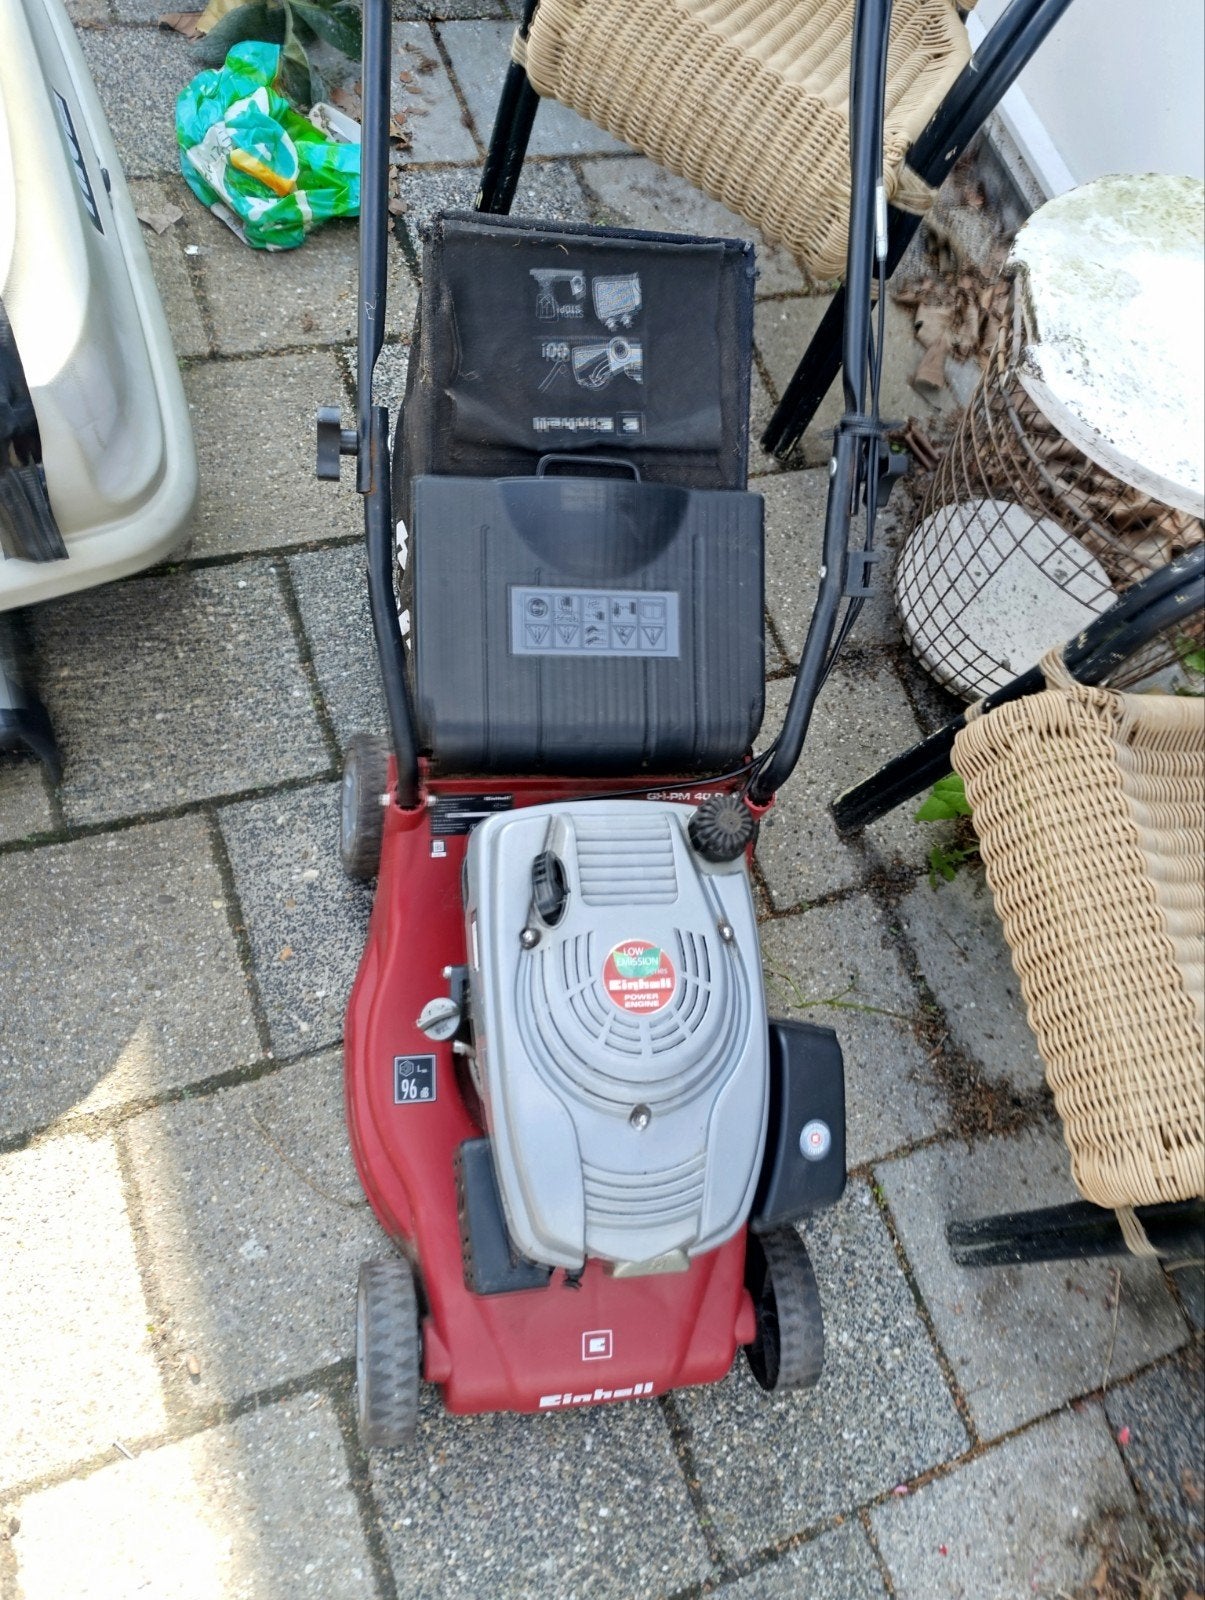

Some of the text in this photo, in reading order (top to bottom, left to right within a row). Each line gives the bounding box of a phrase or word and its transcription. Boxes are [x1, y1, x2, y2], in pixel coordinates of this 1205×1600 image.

[533, 417, 615, 434] Einhell
[646, 792, 691, 801] GH-PM
[694, 792, 711, 801] 40
[623, 947, 644, 956] LOW
[616, 957, 659, 966] EMISSION
[609, 977, 672, 991] Einhell
[624, 1000, 660, 1008] ENGINE
[401, 1078, 417, 1099] 96
[539, 1381, 654, 1408] Einhell
